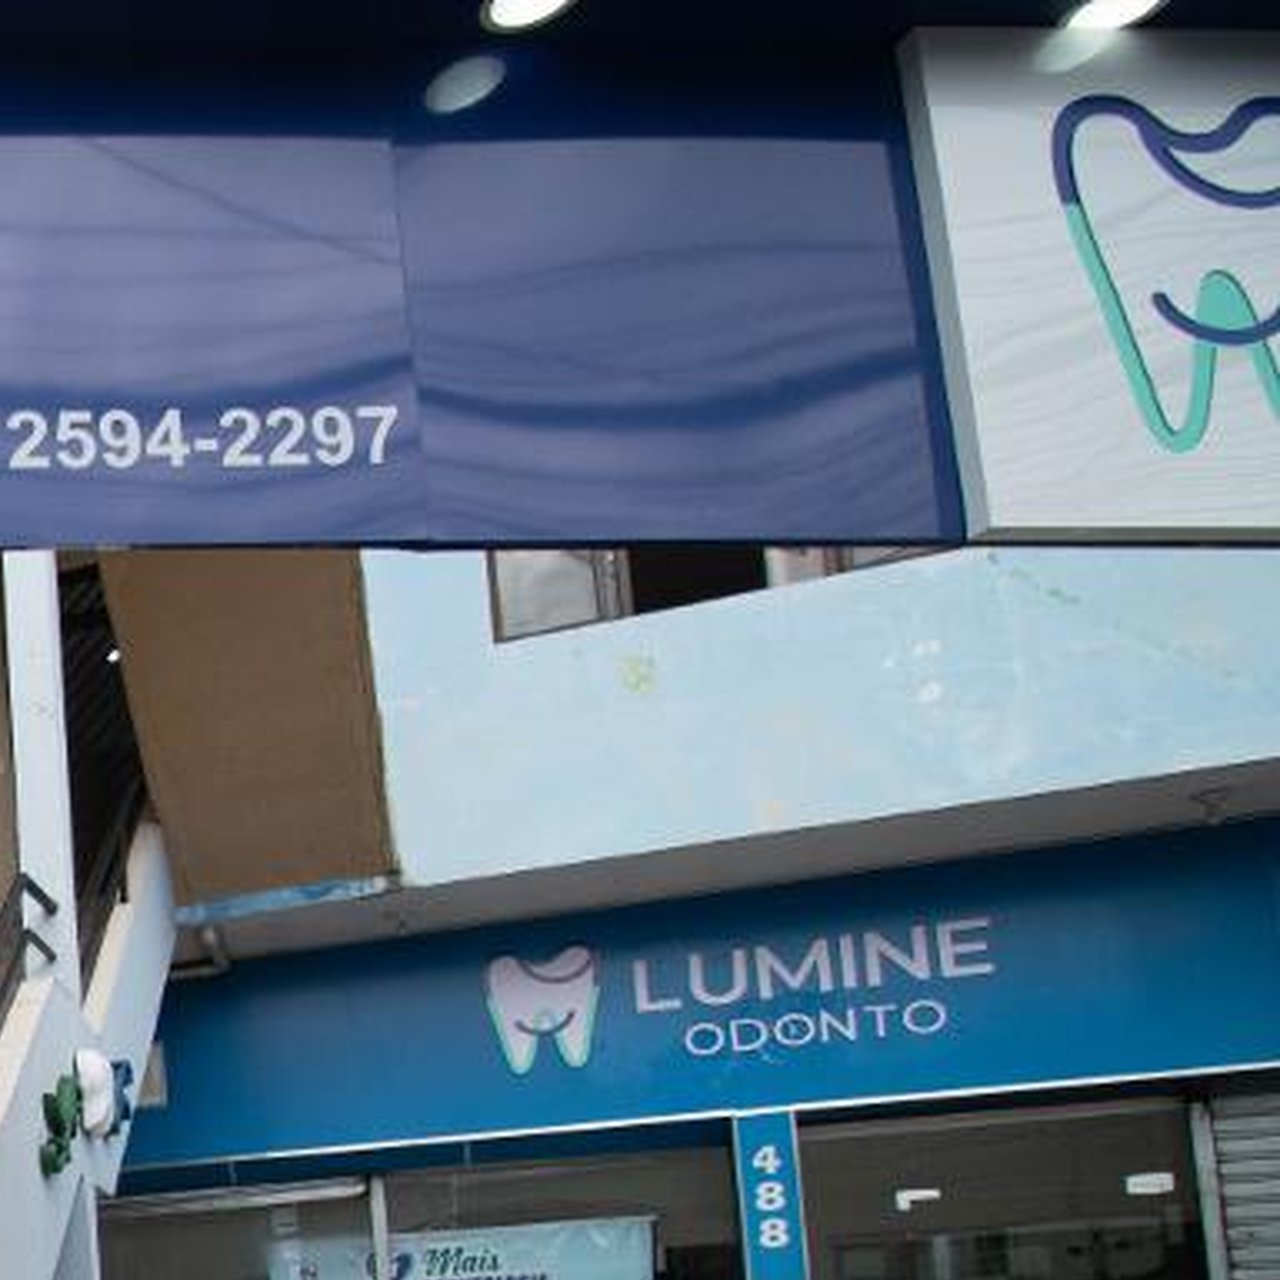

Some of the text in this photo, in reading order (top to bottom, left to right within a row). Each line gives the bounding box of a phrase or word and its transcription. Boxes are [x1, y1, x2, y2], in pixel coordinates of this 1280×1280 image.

[6, 404, 399, 468] 2594-2297
[633, 916, 995, 1013] LUMINE
[684, 1000, 946, 1055] ODONTO
[751, 1145, 790, 1248] 488
[424, 1247, 501, 1275] Mais
